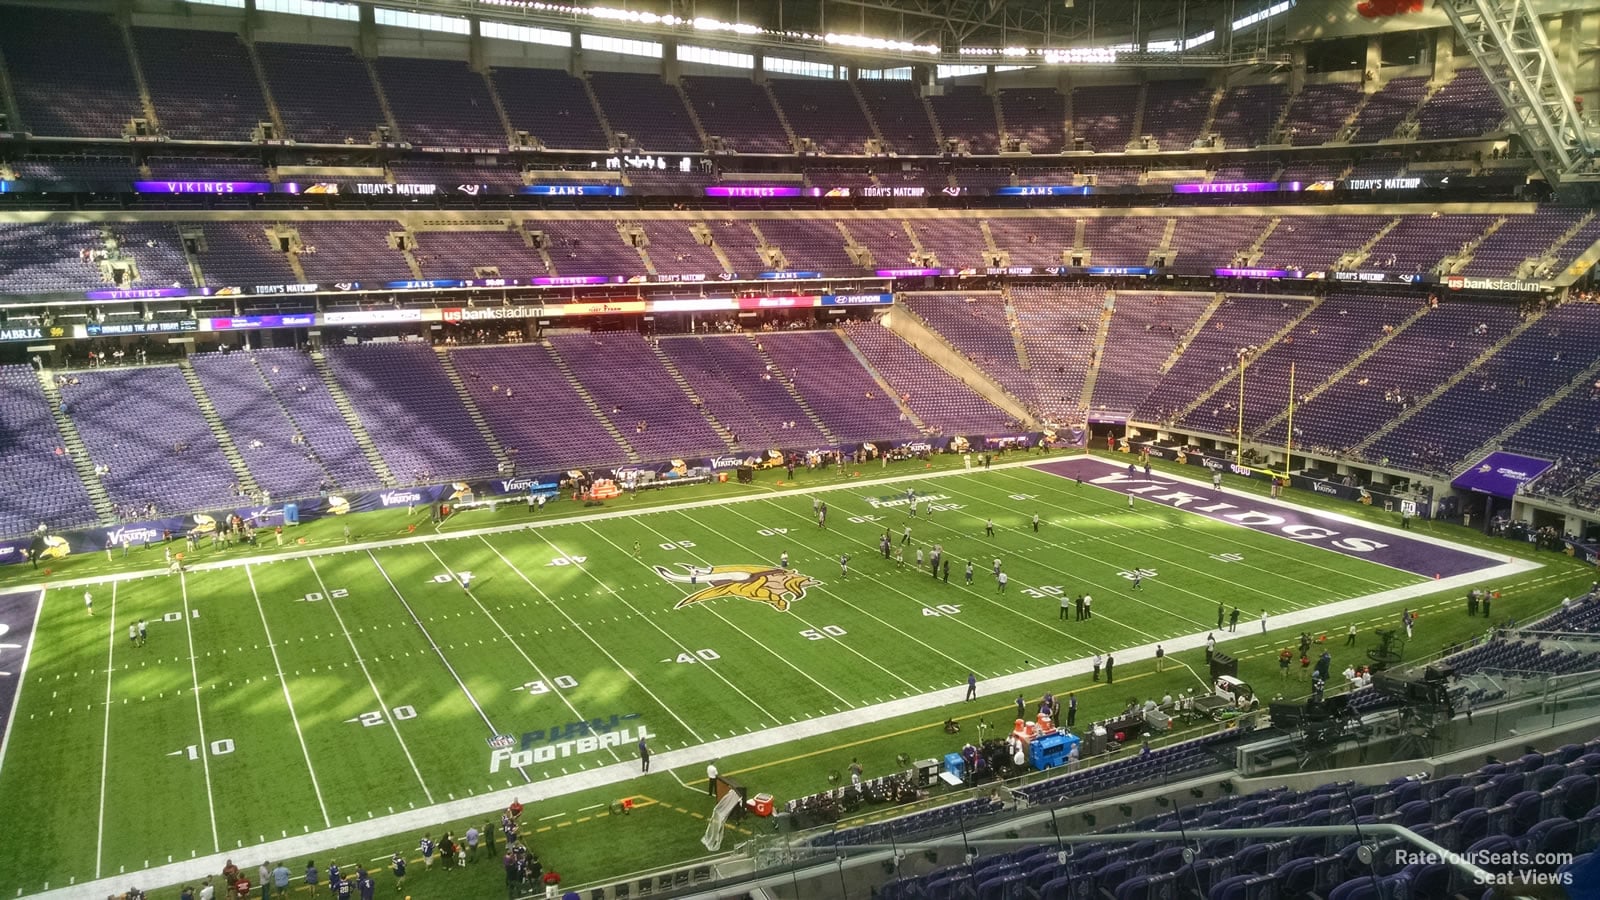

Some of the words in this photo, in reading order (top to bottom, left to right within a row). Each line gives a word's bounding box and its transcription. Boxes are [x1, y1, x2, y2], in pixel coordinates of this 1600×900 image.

[168, 183, 234, 192] VIKINGS
[1198, 183, 1248, 192] VIKINGS
[1350, 179, 1382, 189] TODAY'S
[1384, 178, 1420, 189] MATCHUP
[357, 184, 393, 195] TODAY'S
[397, 184, 436, 194] MATCHUP
[550, 186, 584, 195] RAMS
[728, 188, 774, 196] VIKINGS
[864, 187, 891, 197] TODAY'S
[893, 187, 925, 197] MATCHUP
[1022, 187, 1053, 195] RAMS
[1359, 272, 1385, 281] MATCHUP
[112, 290, 160, 298] VIKINGS
[256, 285, 284, 293] TODAY'S
[287, 284, 318, 293] MATCHUP
[1089, 472, 1388, 551] VIKINGS
[659, 540, 696, 551] 50
[1021, 586, 1062, 598] 30
[922, 603, 962, 617] 40
[798, 624, 847, 640] 50
[676, 648, 721, 664] 40
[524, 674, 578, 696] 30
[359, 705, 417, 727] 20
[186, 738, 235, 760] 10
[490, 726, 656, 773] FOOTBALL
